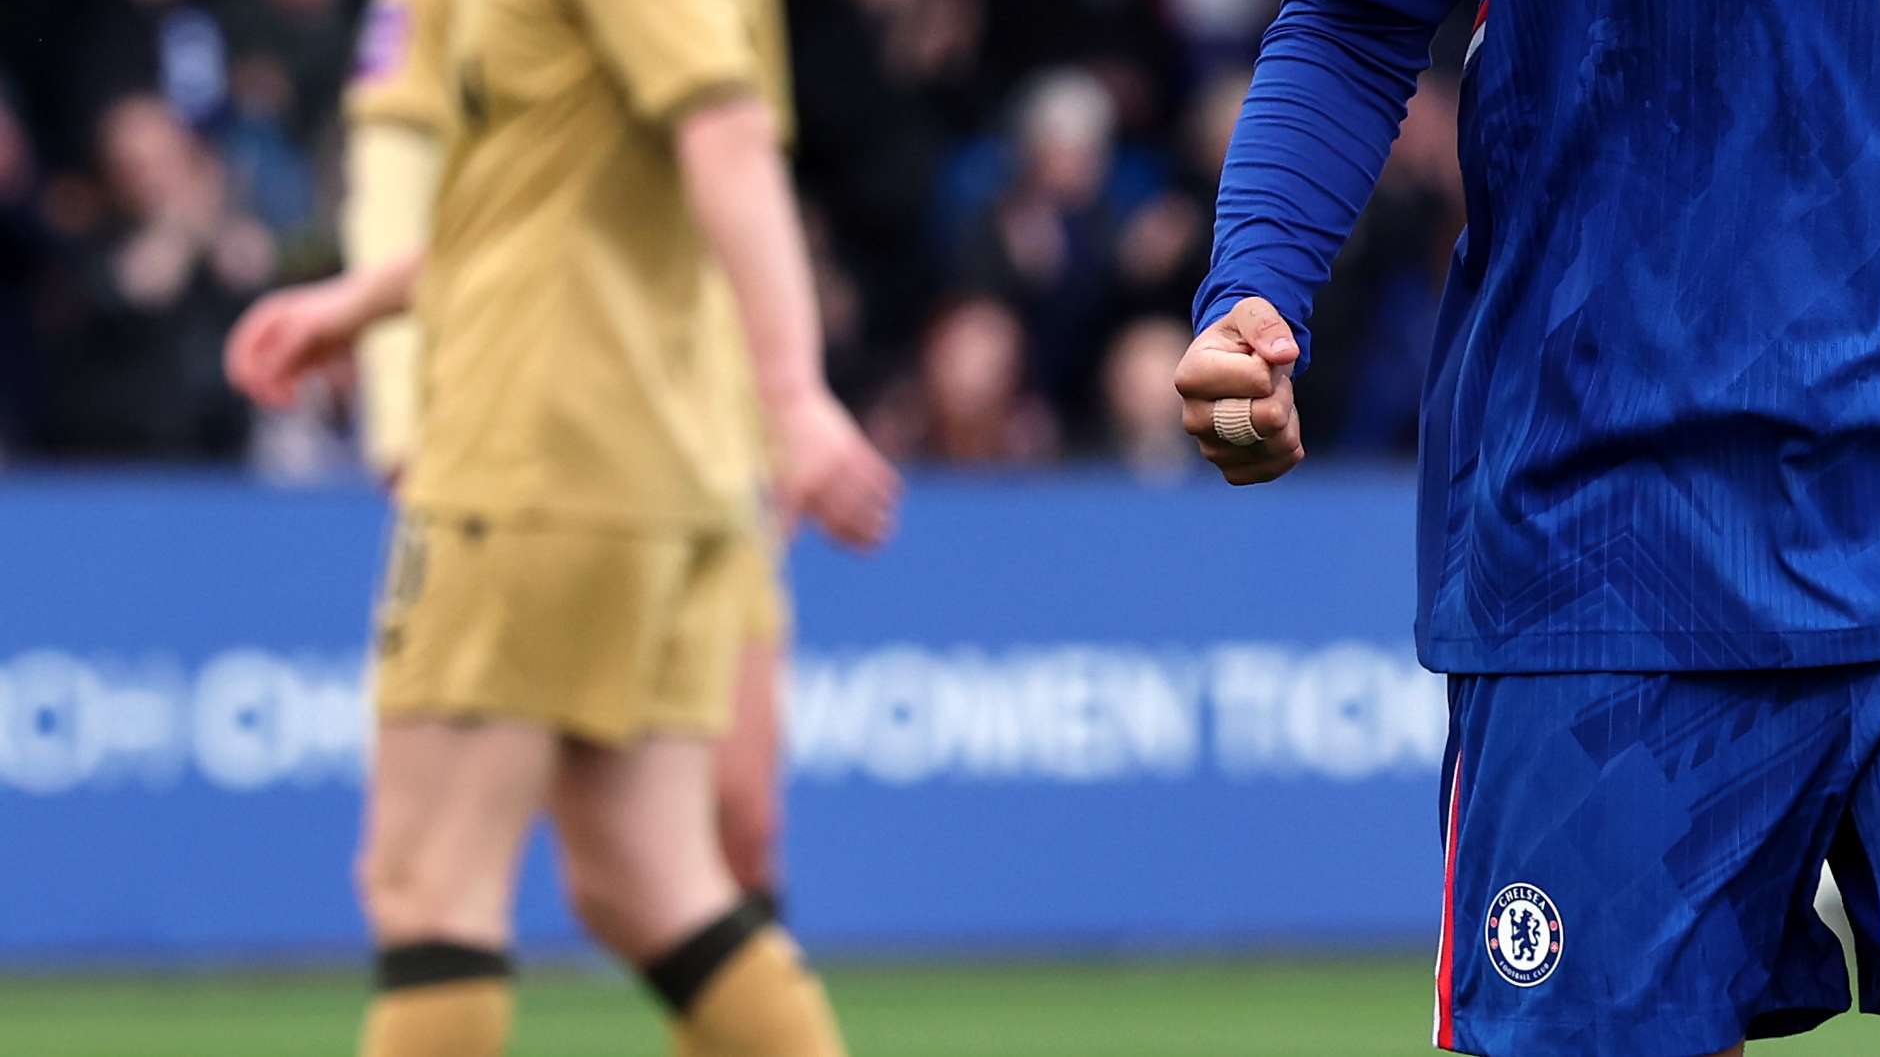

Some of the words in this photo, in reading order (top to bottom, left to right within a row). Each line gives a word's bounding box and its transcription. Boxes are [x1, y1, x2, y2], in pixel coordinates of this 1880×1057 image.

[1498, 887, 1546, 911] CHELSEA
[1498, 960, 1531, 981] FOOTBALL
[1533, 962, 1550, 979] CLUB
